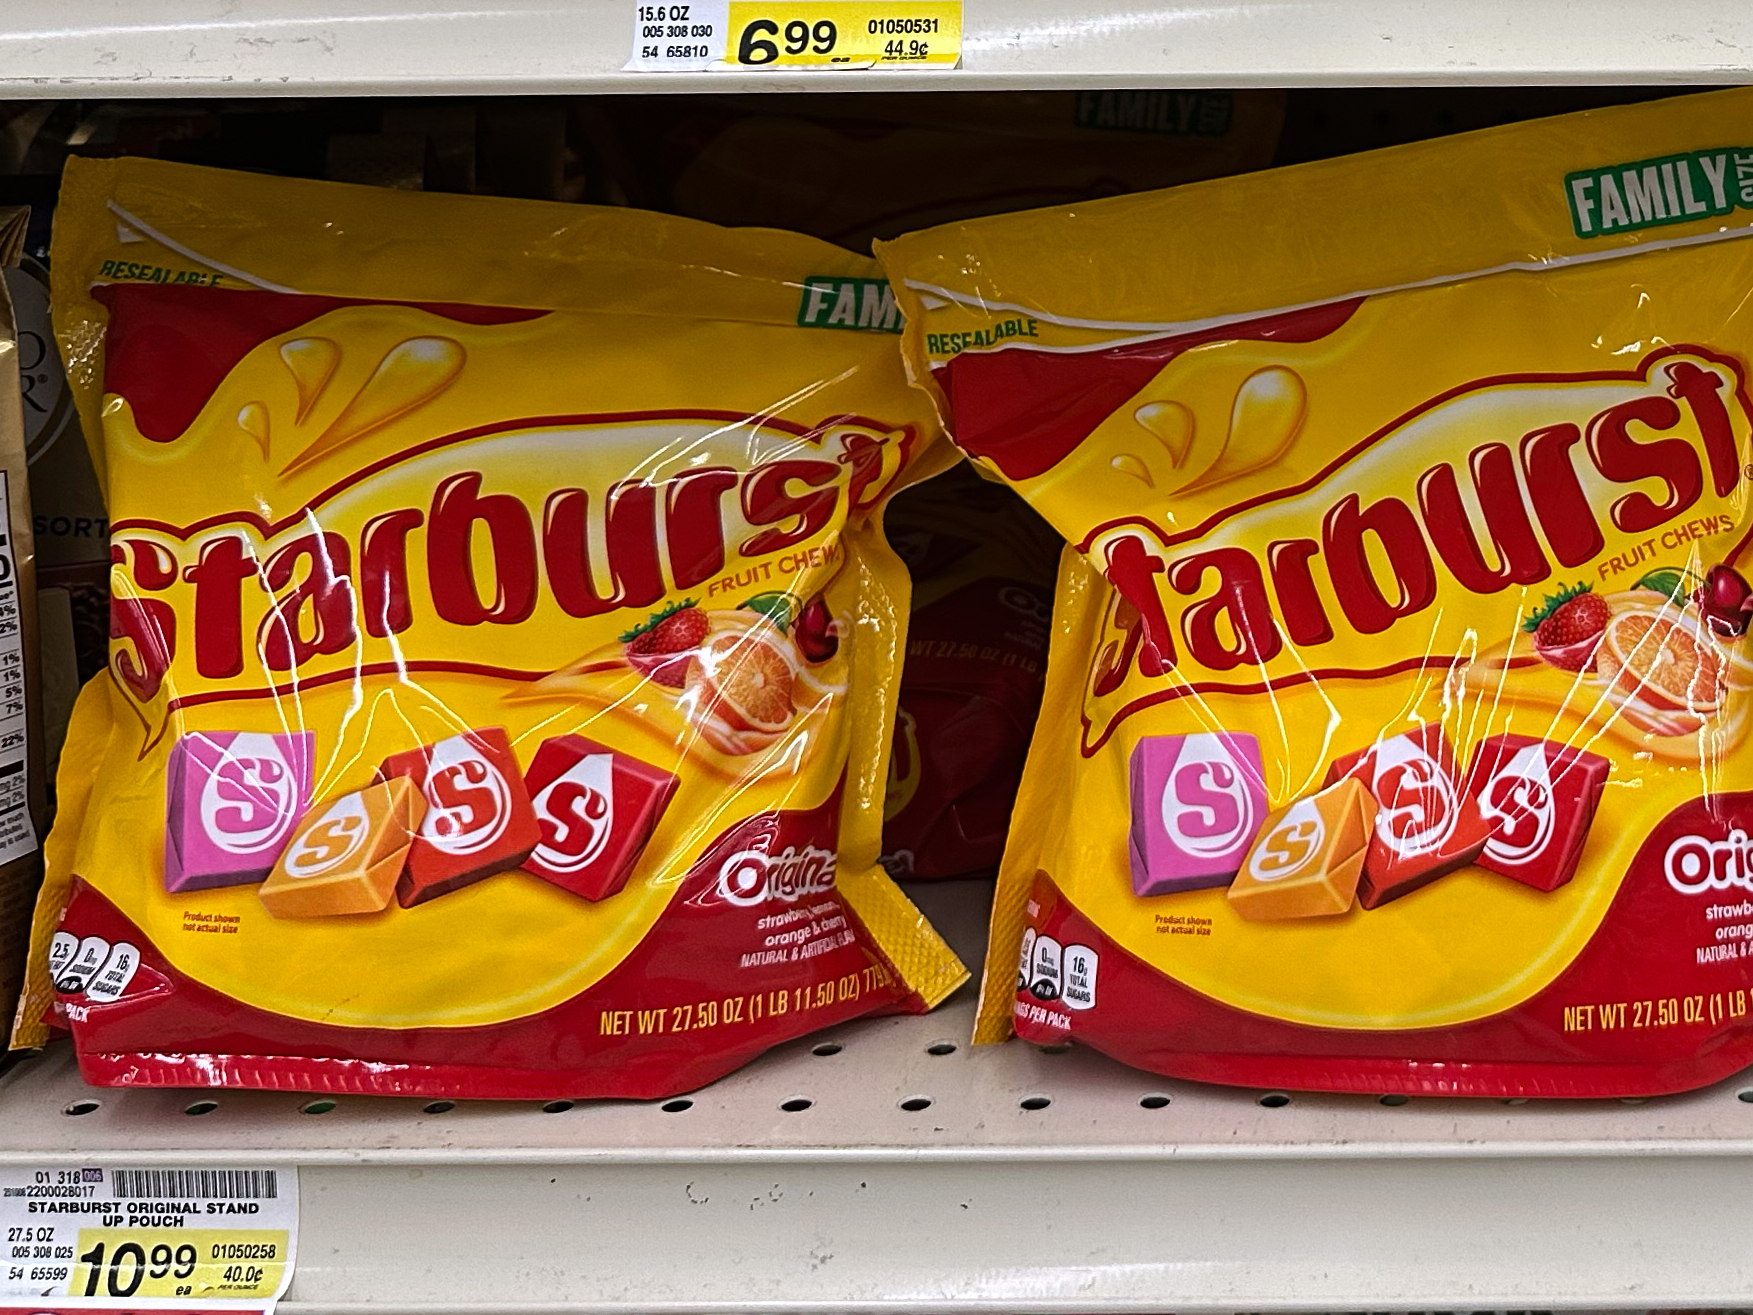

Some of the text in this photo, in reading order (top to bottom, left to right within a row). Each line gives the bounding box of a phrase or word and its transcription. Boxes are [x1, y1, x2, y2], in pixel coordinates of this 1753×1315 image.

[638, 6, 690, 21] 15.6 OZ
[868, 18, 939, 34] 01050531
[885, 40, 928, 57] 44.9¢
[1573, 154, 1731, 233] FAMILY
[927, 317, 1039, 354] RESEALABLE
[1598, 512, 1735, 582] FRUIT CHEWS
[109, 431, 907, 702] Starburst
[708, 561, 775, 600] FRUIT
[1564, 1005, 1595, 1031] NET
[1600, 1003, 1628, 1029] WT
[1632, 999, 1678, 1027] 27.50
[1683, 996, 1704, 1022] OZ
[1710, 993, 1723, 1025] (1
[1729, 991, 1746, 1017] LB
[26, 1186, 95, 1197] 2200028017
[29, 1203, 259, 1214] STARBURST ORIGINAL STAND
[102, 1216, 184, 1227] UP POUCH
[8, 1227, 54, 1242] 27.5 OZ
[212, 1244, 276, 1259] 01050258
[223, 1266, 263, 1282] 40.0¢
